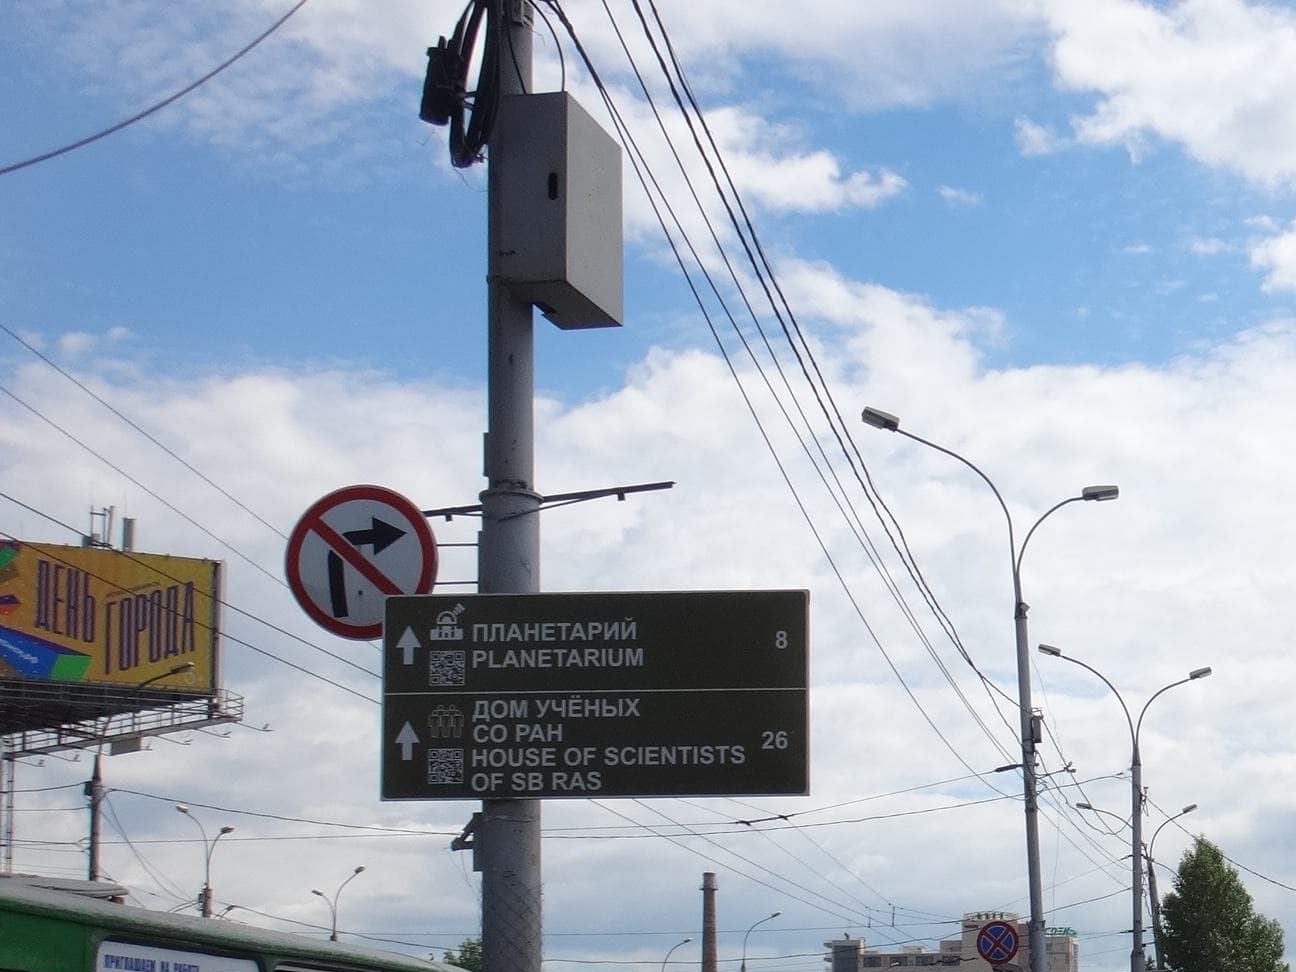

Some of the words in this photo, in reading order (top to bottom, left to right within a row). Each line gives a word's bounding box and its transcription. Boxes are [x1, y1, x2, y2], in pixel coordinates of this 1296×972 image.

[35, 559, 95, 643] ДЕНЬ
[105, 581, 195, 676] ГОРОДА
[472, 616, 637, 642] ПЛАНЕТАРИЙ
[775, 630, 788, 649] 8
[472, 648, 645, 668] PLANETARIUM
[472, 700, 528, 723] ДОМ
[534, 695, 641, 720] УЧЁНЫХ
[472, 725, 507, 743] СО
[516, 724, 563, 742] РАН
[761, 731, 788, 750] 26
[472, 747, 556, 767] HOUSE
[564, 747, 596, 766] OF
[604, 745, 746, 765] SCIENTISTS
[472, 773, 503, 792] OF
[511, 772, 544, 791] SB
[552, 771, 601, 790] RAS
[104, 954, 156, 972] ПРИГЛАШАЕМ
